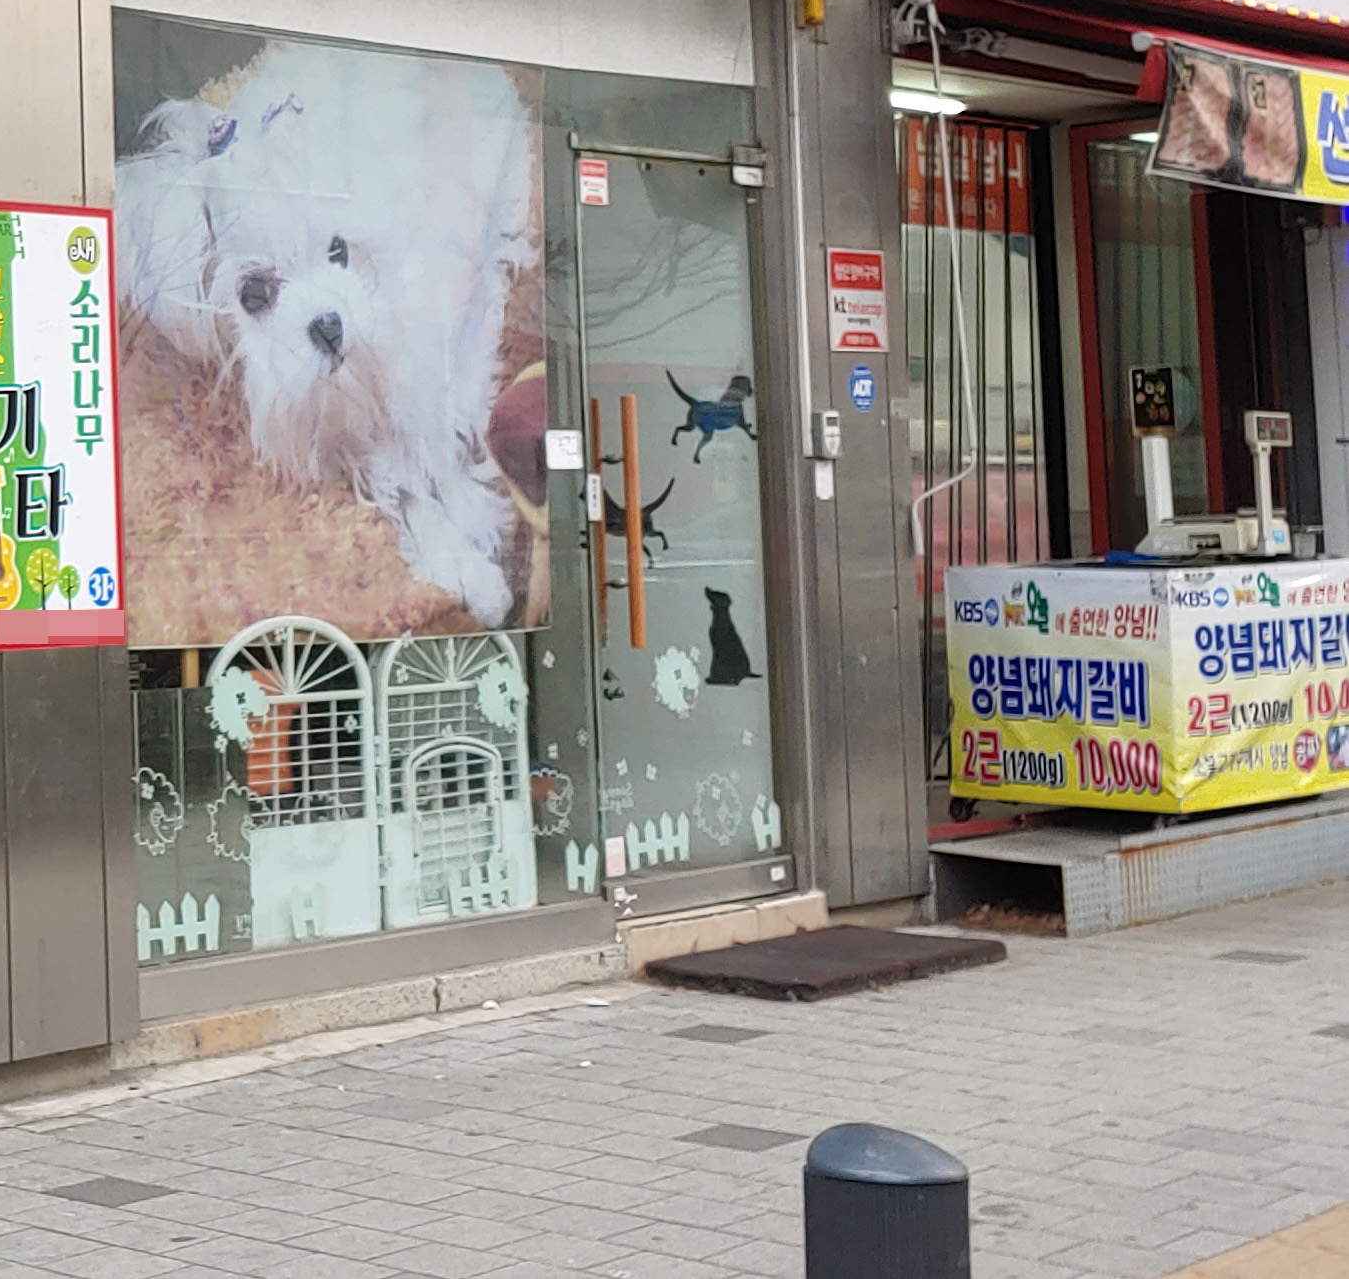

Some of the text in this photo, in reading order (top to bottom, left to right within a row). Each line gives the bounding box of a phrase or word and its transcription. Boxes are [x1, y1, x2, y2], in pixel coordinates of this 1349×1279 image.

[70, 279, 105, 457] 소리나무
[90, 571, 115, 603] 3F
[1178, 588, 1211, 607] KBS
[954, 600, 984, 622] KBS
[1069, 606, 1110, 637] 출연한
[968, 653, 1148, 725] 양념돼지갈비
[1073, 736, 1161, 792] 10,000
